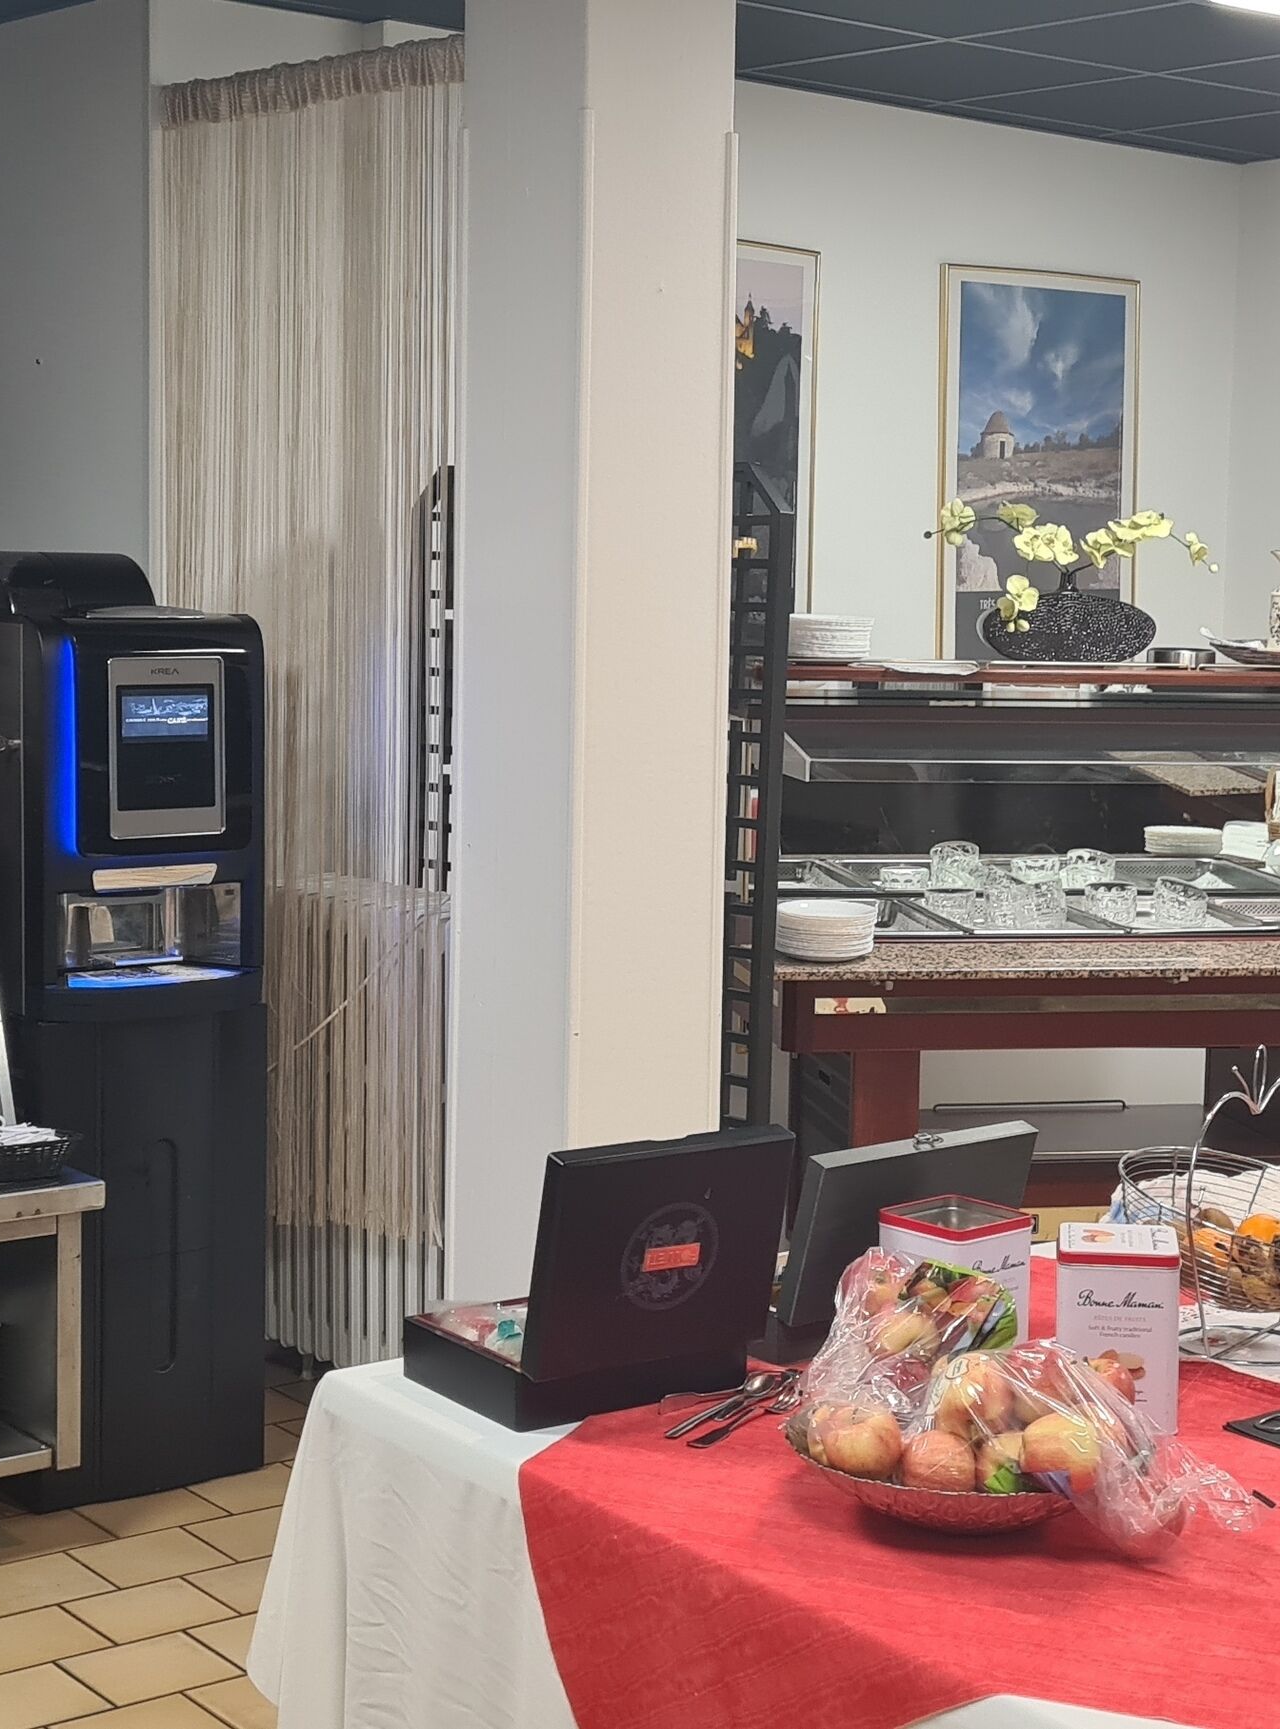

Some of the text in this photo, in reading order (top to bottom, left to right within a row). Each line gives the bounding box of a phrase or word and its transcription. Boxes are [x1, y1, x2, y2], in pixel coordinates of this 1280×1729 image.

[150, 667, 180, 676] KREA
[1077, 1288, 1165, 1309] Bonne Maman
